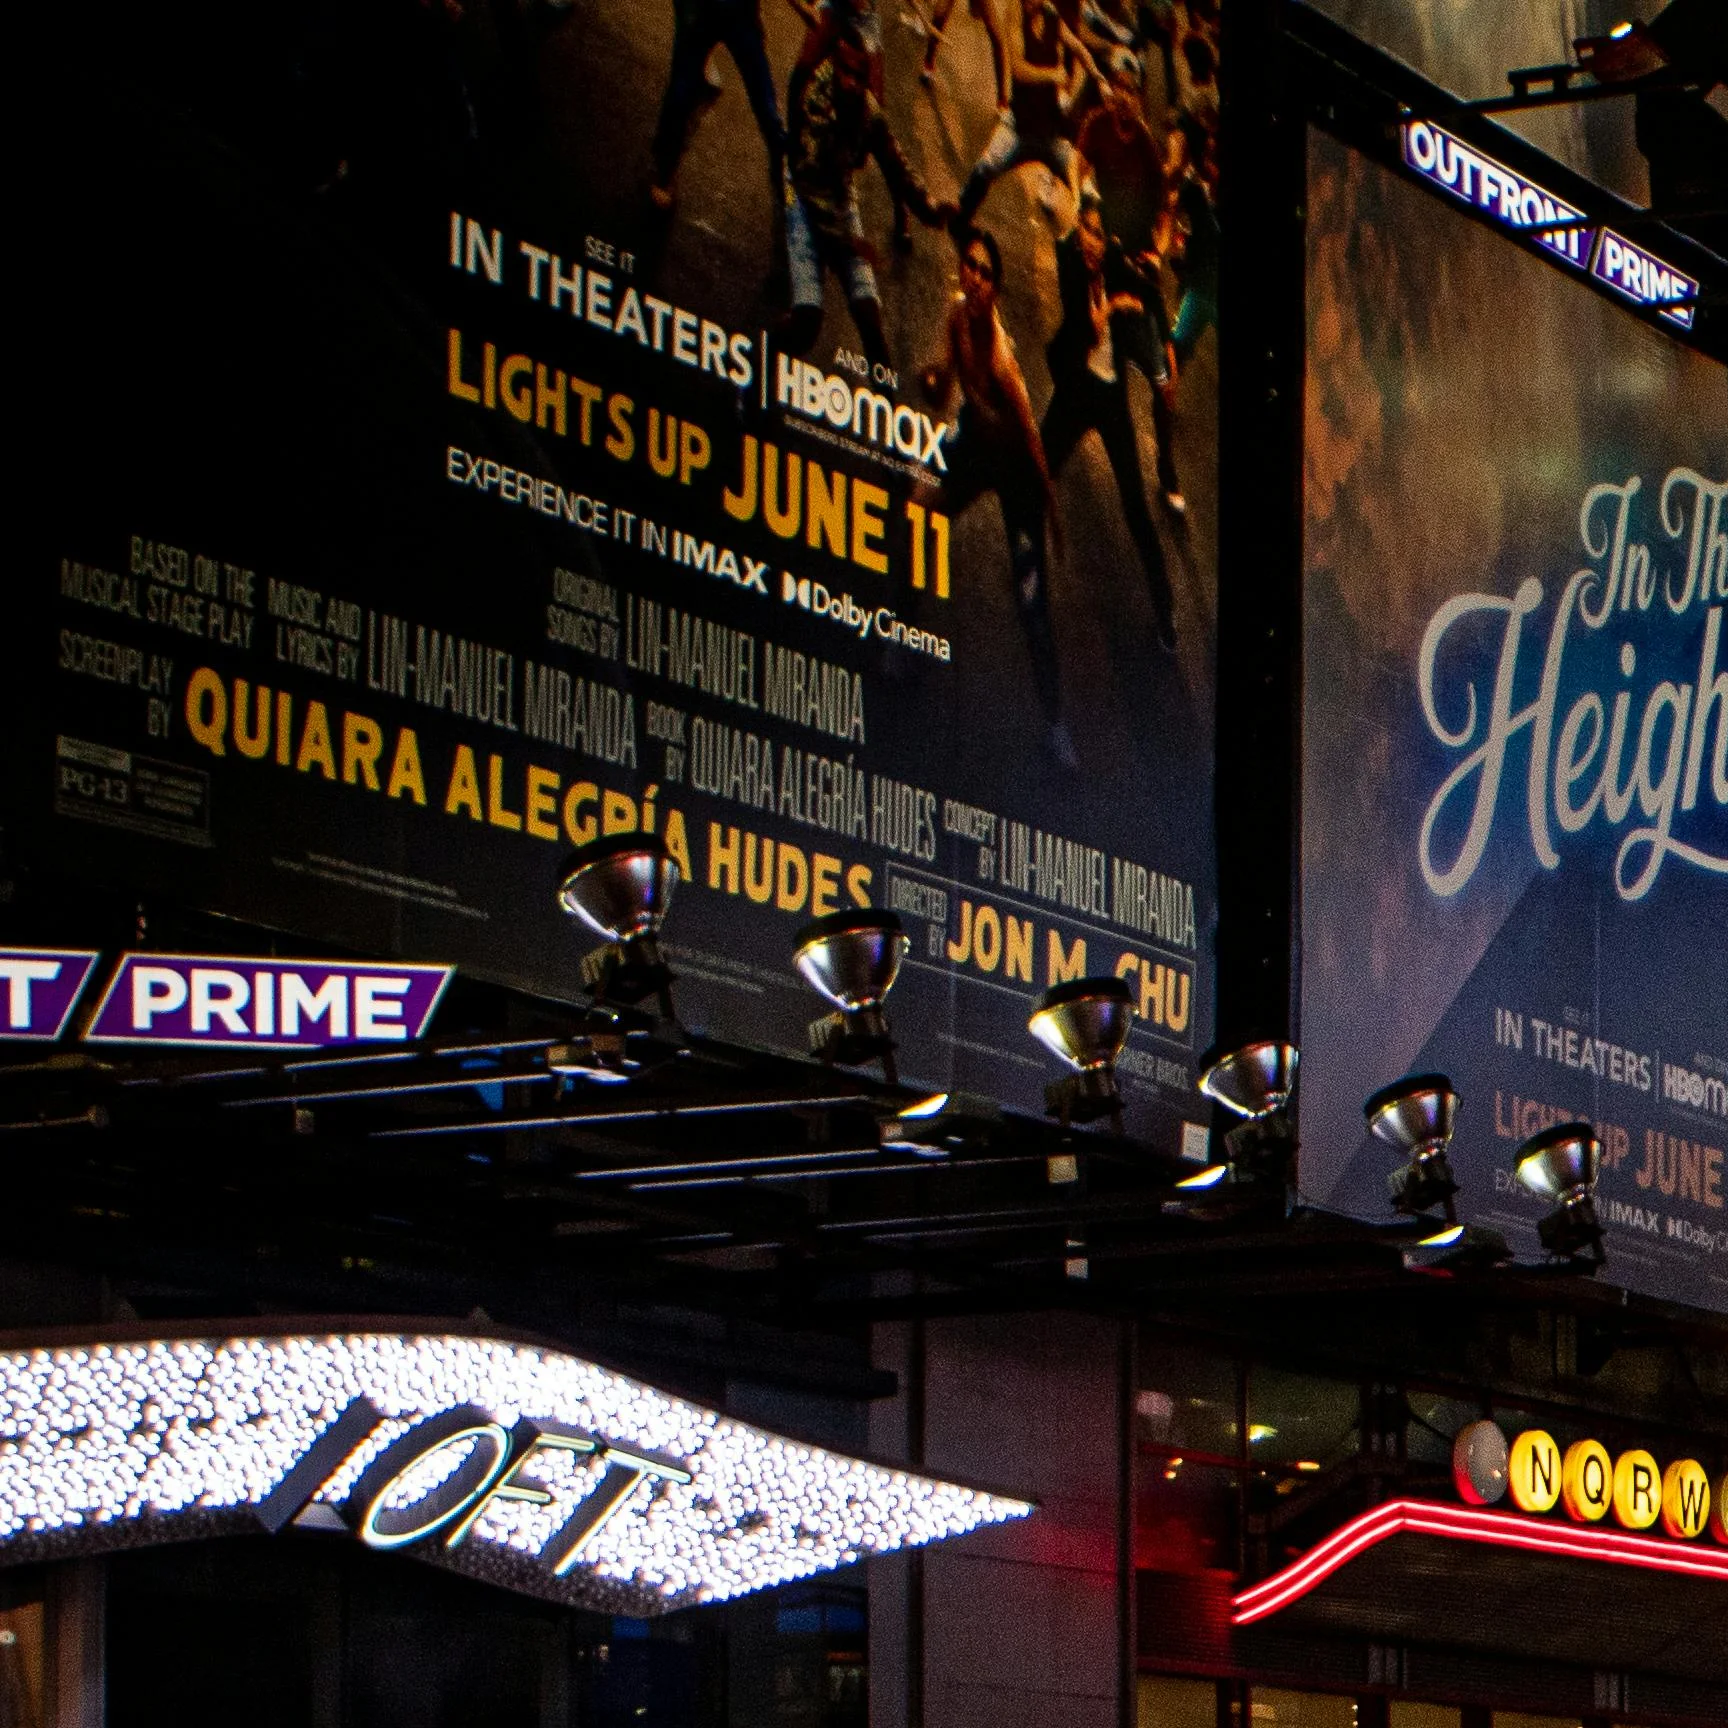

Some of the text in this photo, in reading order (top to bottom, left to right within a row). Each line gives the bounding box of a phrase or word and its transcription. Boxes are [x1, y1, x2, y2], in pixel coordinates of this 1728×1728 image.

[449, 210, 753, 390] IN THEATERS
[1603, 235, 1692, 320] PRIME
[447, 325, 636, 463] LIGHTS
[647, 404, 712, 486] UP
[721, 434, 890, 576] JUNE
[904, 501, 951, 600] 11
[776, 350, 948, 473] HBOmax
[446, 445, 769, 596] EXPERIENCE IT IN IMAX
[1579, 474, 1657, 628] In
[57, 626, 175, 692] SCREENPLAY
[625, 592, 866, 744] LIN-MANUEL MIRANDA
[810, 582, 951, 662] Dolby Cinema
[146, 698, 172, 739] BY
[366, 610, 638, 770] LIN-MANUEL MIRANDA
[184, 665, 428, 807] QUIARA
[707, 820, 873, 918] HUDES
[690, 715, 773, 813] QUIARA
[871, 772, 937, 862] HUDES
[946, 900, 1033, 985] JON
[1000, 818, 1197, 949] LIN-MANUEL MIRANDA
[131, 965, 412, 1040] PRIME
[1494, 1007, 1524, 1049] IN
[1531, 1018, 1651, 1092] THEATERS
[1636, 1128, 1724, 1208] JUNE
[255, 1396, 692, 1578] LOFT
